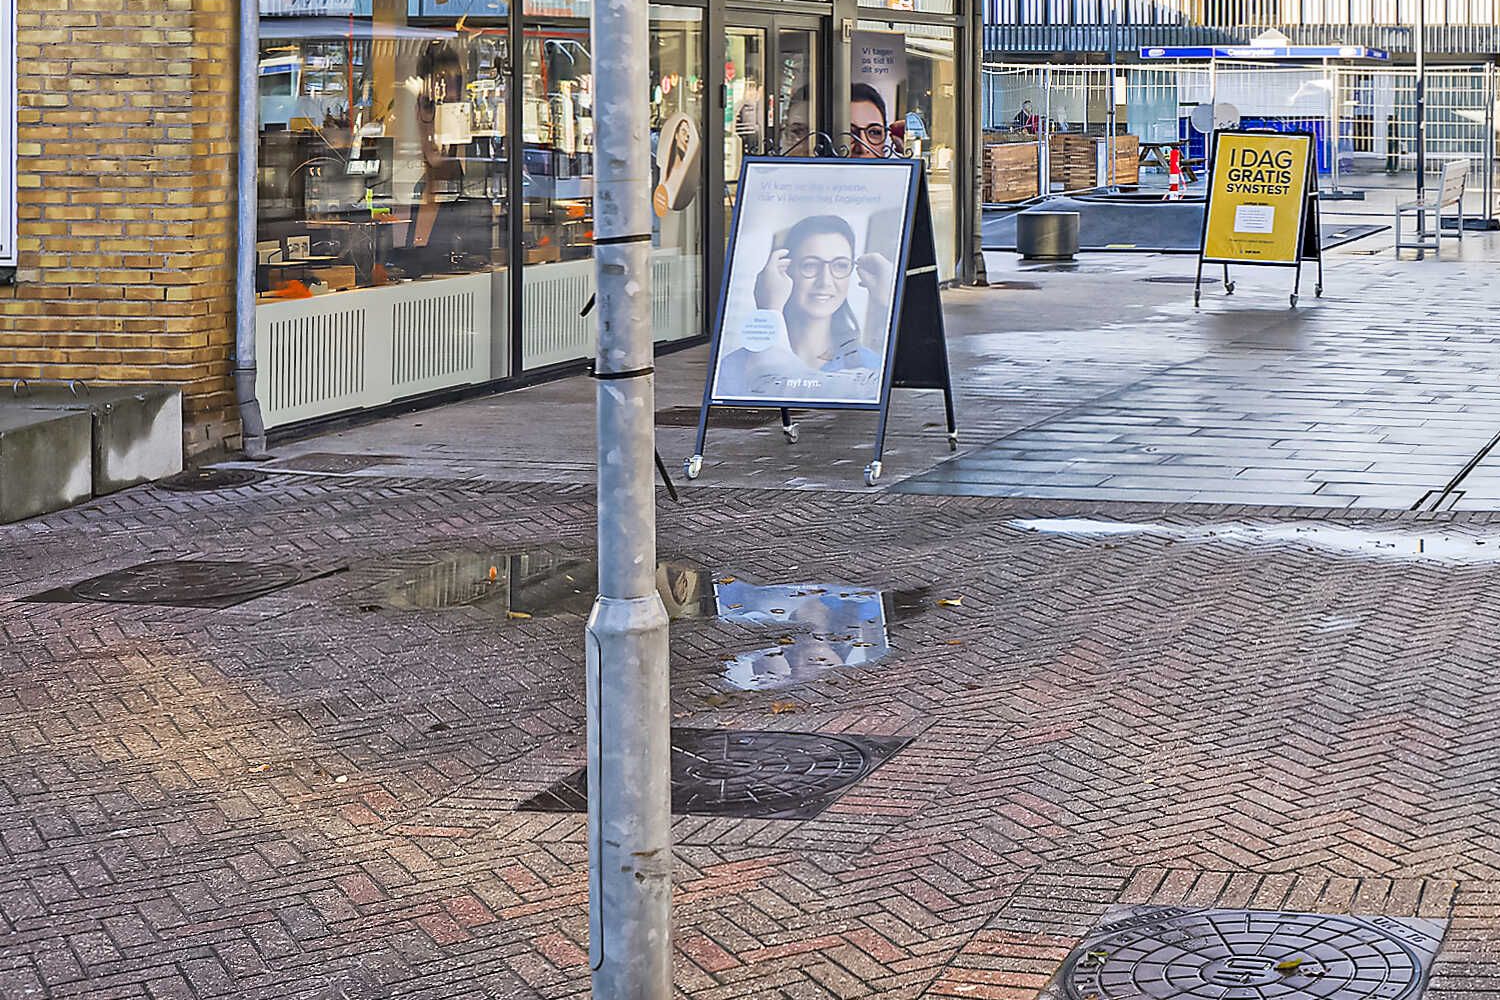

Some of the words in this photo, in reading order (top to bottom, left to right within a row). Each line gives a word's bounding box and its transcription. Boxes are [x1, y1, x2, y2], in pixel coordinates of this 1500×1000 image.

[873, 57, 885, 65] tid
[1230, 148, 1237, 167] I
[1241, 149, 1293, 169] DAG
[1228, 168, 1293, 184] GRATIS
[1226, 183, 1291, 195] SYNSTEST
[786, 378, 801, 388] nyt
